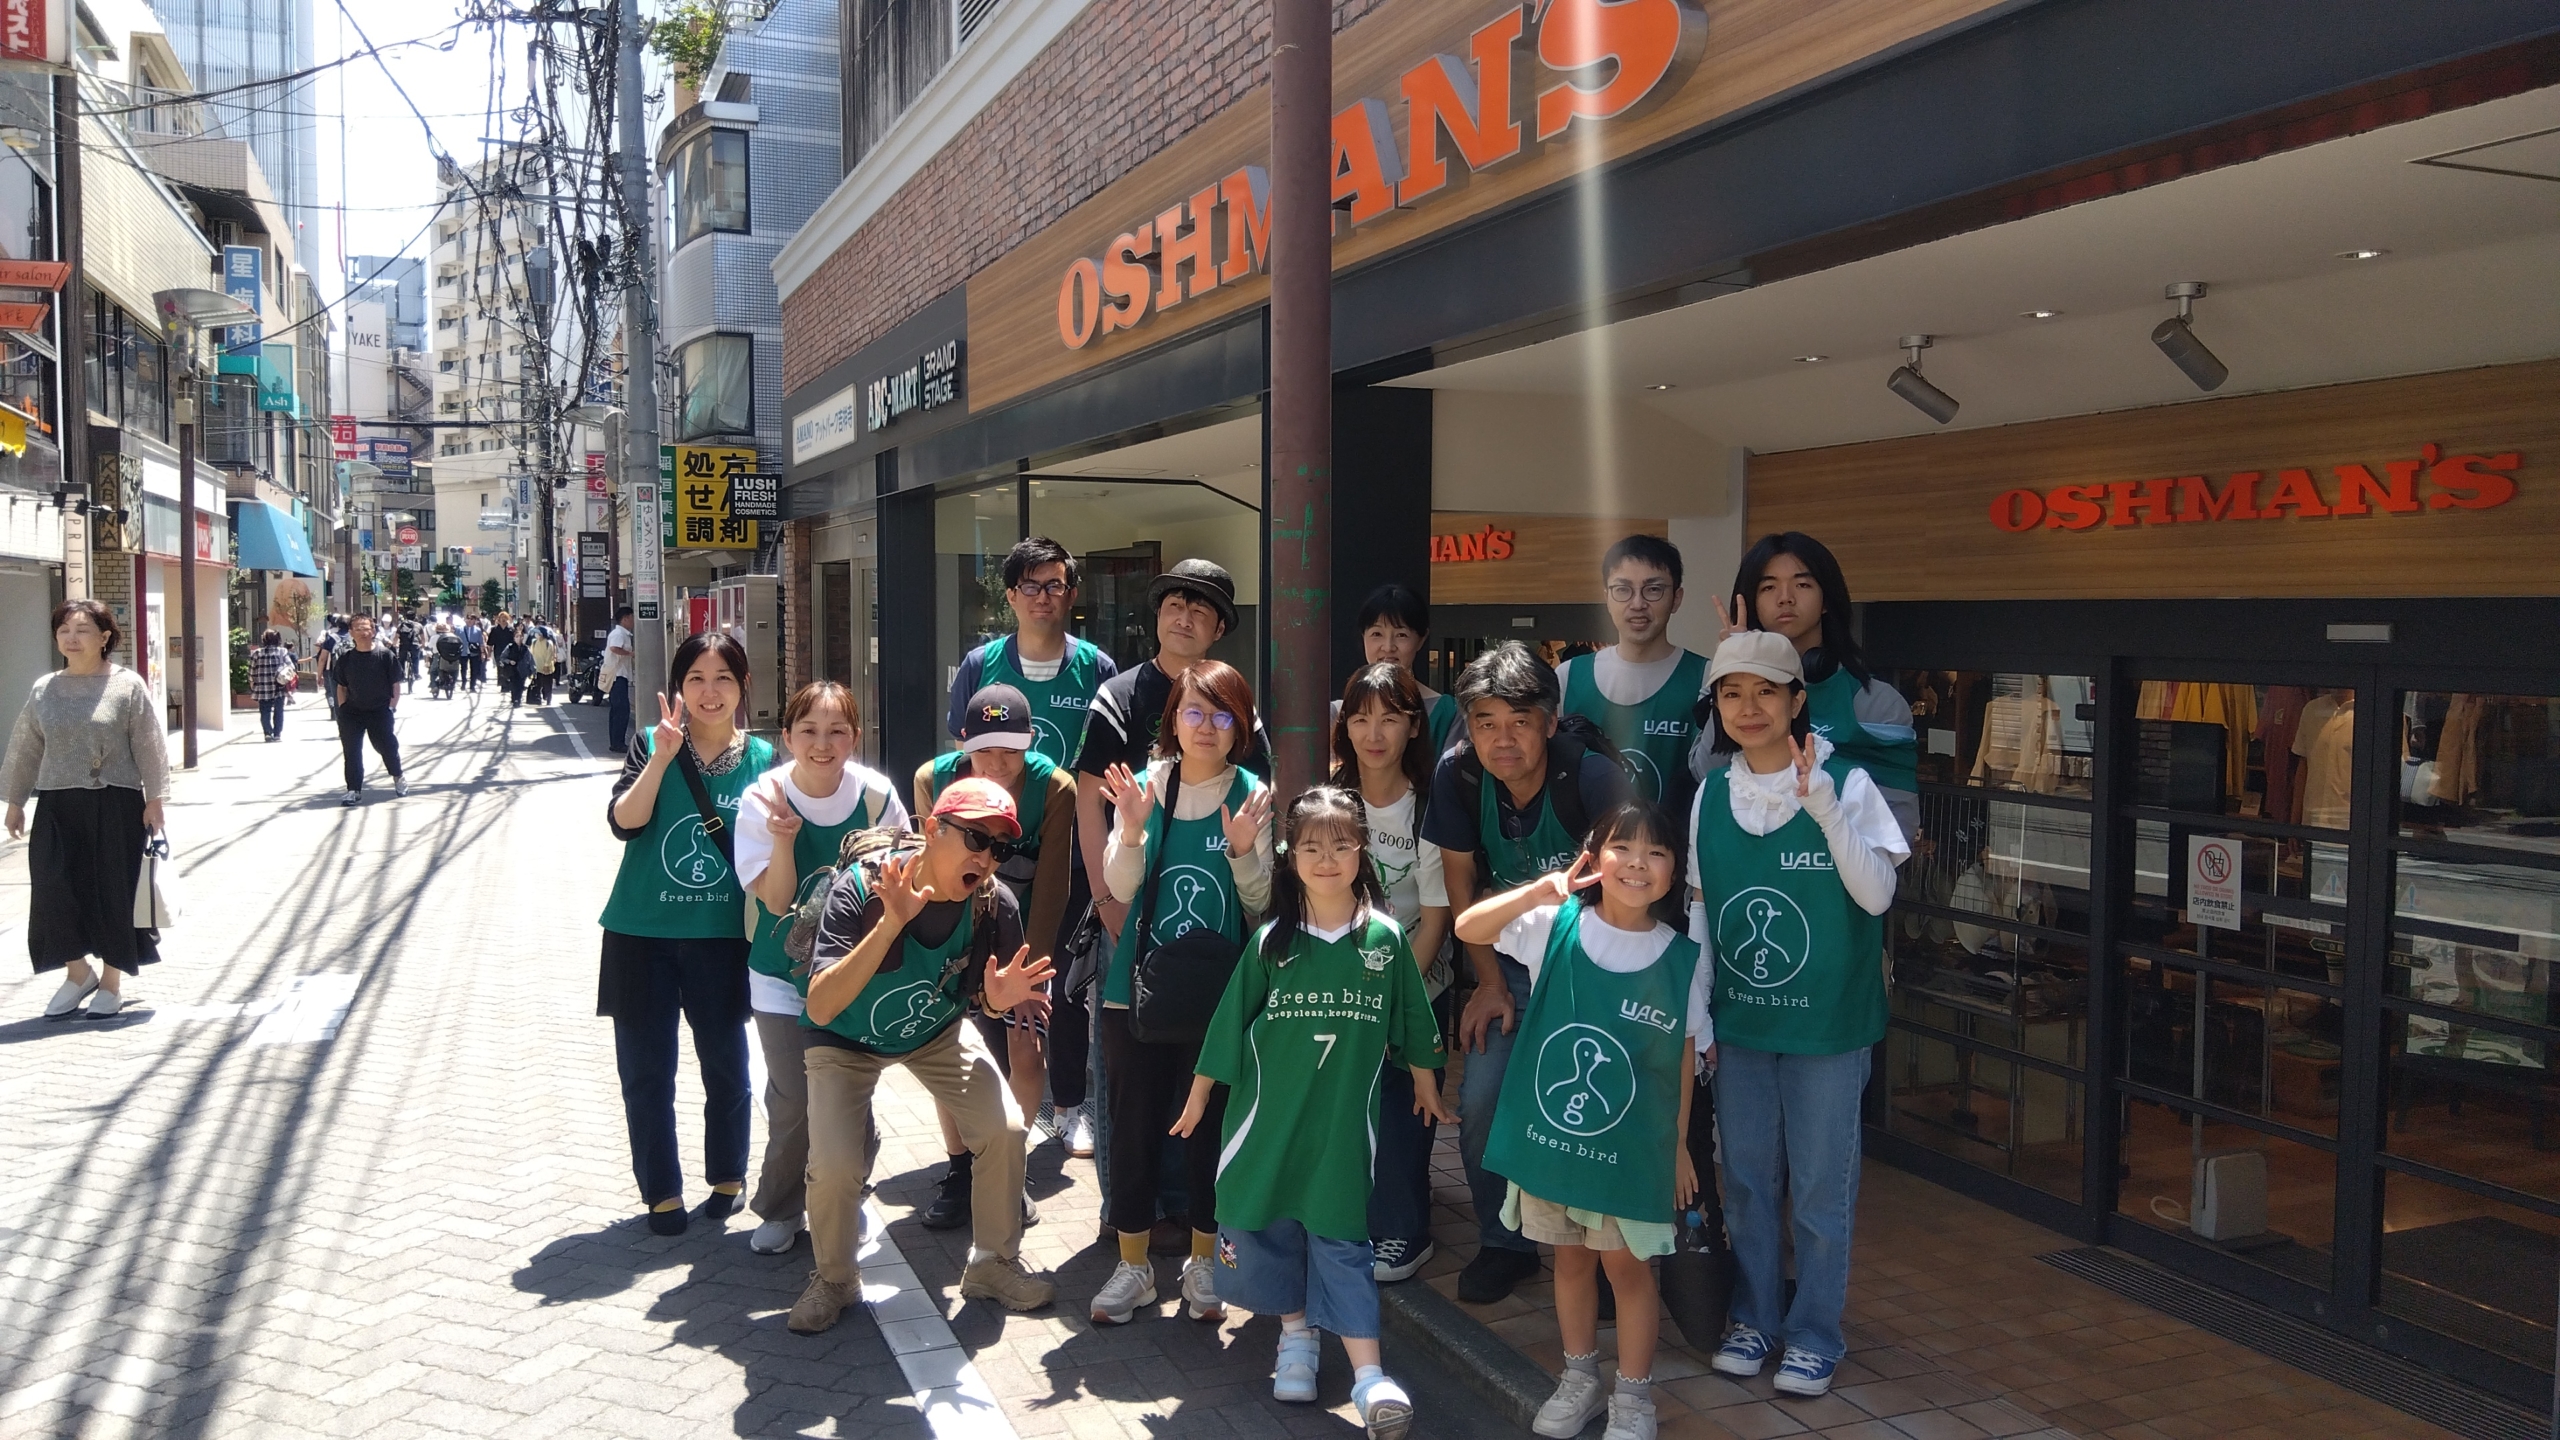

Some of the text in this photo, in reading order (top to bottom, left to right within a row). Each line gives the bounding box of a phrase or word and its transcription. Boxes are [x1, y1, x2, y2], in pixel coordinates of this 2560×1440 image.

[16, 266, 53, 281] salon
[924, 339, 957, 380] GRAND
[868, 365, 918, 433] ABC-MART
[924, 372, 954, 410] STAGE
[264, 396, 288, 407] Ash
[734, 478, 777, 490] LUSH
[1989, 443, 2522, 532] OSHMAN'S
[101, 457, 118, 544] KABNA
[734, 491, 777, 502] FRESH
[734, 501, 777, 509] HANDMADE
[734, 508, 777, 516] COSMETICS
[1050, 694, 1089, 709] UACJ
[1644, 719, 1689, 736] UACJ
[660, 890, 729, 902] green bird
[2192, 896, 2235, 911] 店内飲食禁止
[1268, 988, 1383, 1010] green bird
[1771, 995, 1810, 1008] bird
[1619, 999, 1678, 1033] UACJ
[1313, 1033, 1337, 1070] 7
[1526, 1123, 1619, 1165] green bird
